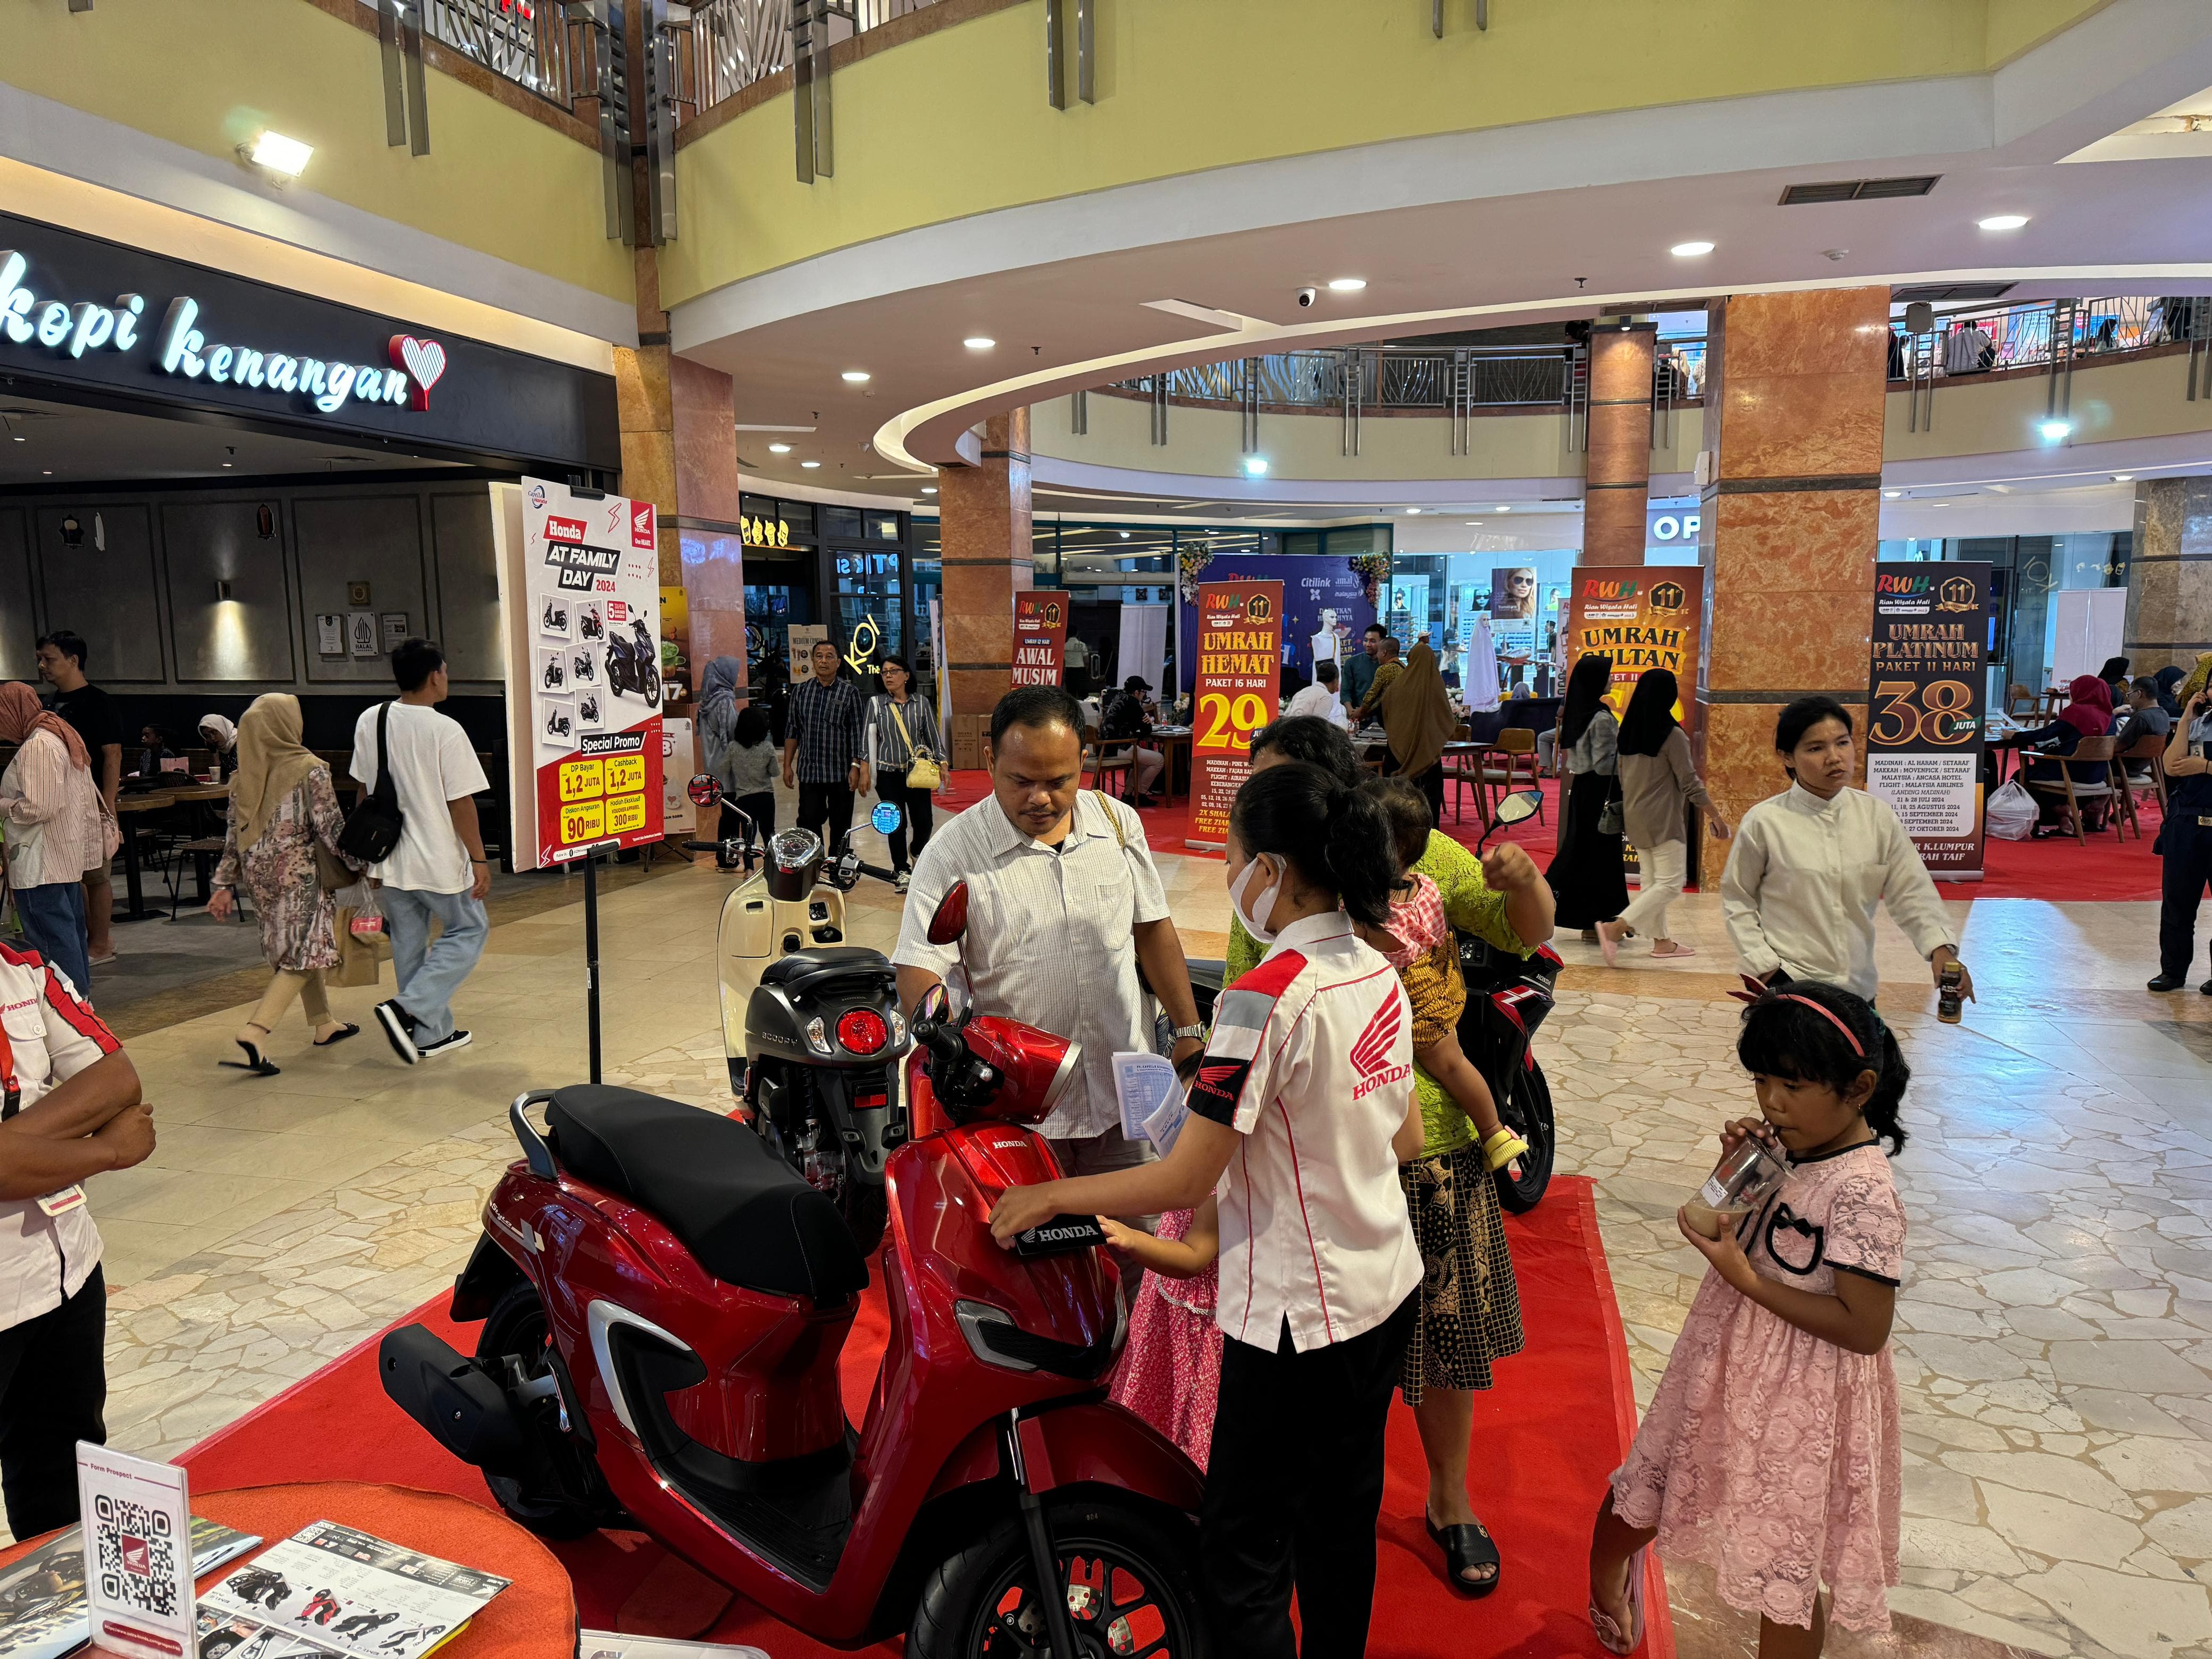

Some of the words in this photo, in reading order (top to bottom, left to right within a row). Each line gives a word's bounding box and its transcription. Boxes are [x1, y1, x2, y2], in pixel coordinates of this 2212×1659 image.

[0, 251, 144, 358] kopi
[163, 296, 407, 413] kenangan
[549, 520, 582, 540] Honda
[548, 545, 565, 562] AT
[568, 547, 617, 568] FAMILY
[562, 569, 592, 586] DAY
[596, 579, 616, 592] 2024
[1301, 577, 1331, 588] Citilink
[1335, 575, 1353, 585] amal
[1582, 579, 1638, 598] RWH
[1877, 574, 1930, 593] RWH
[1205, 593, 1241, 609] RWH
[608, 602, 615, 619] 5
[1203, 632, 1274, 651] UMRAH
[1584, 627, 1680, 648] UMRAH
[1889, 624, 1965, 641] UMRAH
[843, 613, 881, 675] KOI
[1873, 641, 1979, 658] PLATINUM
[1016, 648, 1055, 666] AWAL
[1201, 654, 1274, 675] HEMAT
[1876, 661, 1920, 672] PAKET
[1942, 661, 1976, 672] HARI
[1011, 667, 1058, 686] MUSIM
[1205, 678, 1232, 688] PAKET
[1235, 678, 1244, 688] 16
[1246, 678, 1266, 688] HARI
[1196, 693, 1268, 750] 29
[1869, 680, 1976, 745] 38
[1954, 721, 1976, 731] JUTA
[582, 737, 613, 753] Special
[615, 735, 640, 748] Promo
[580, 764, 594, 772] Bayar
[614, 758, 638, 767] Cashback
[565, 775, 583, 798] 1,2
[584, 777, 600, 787] JUTA
[610, 769, 626, 791] 1,2
[627, 771, 642, 781] JUTA
[580, 803, 600, 812] Angsuran
[567, 816, 585, 840] 90
[585, 818, 600, 830] RIBU
[614, 814, 627, 827] 300
[762, 1032, 798, 1047] SCOOPY
[1194, 1080, 1234, 1101] HONDA
[1353, 1063, 1412, 1101] HONDA
[993, 1140, 1028, 1149] HONDA
[1038, 1225, 1099, 1242] HONDA
[90, 1463, 105, 1473] Form
[106, 1467, 132, 1480] Prospect
[127, 1560, 147, 1570] HONDA
